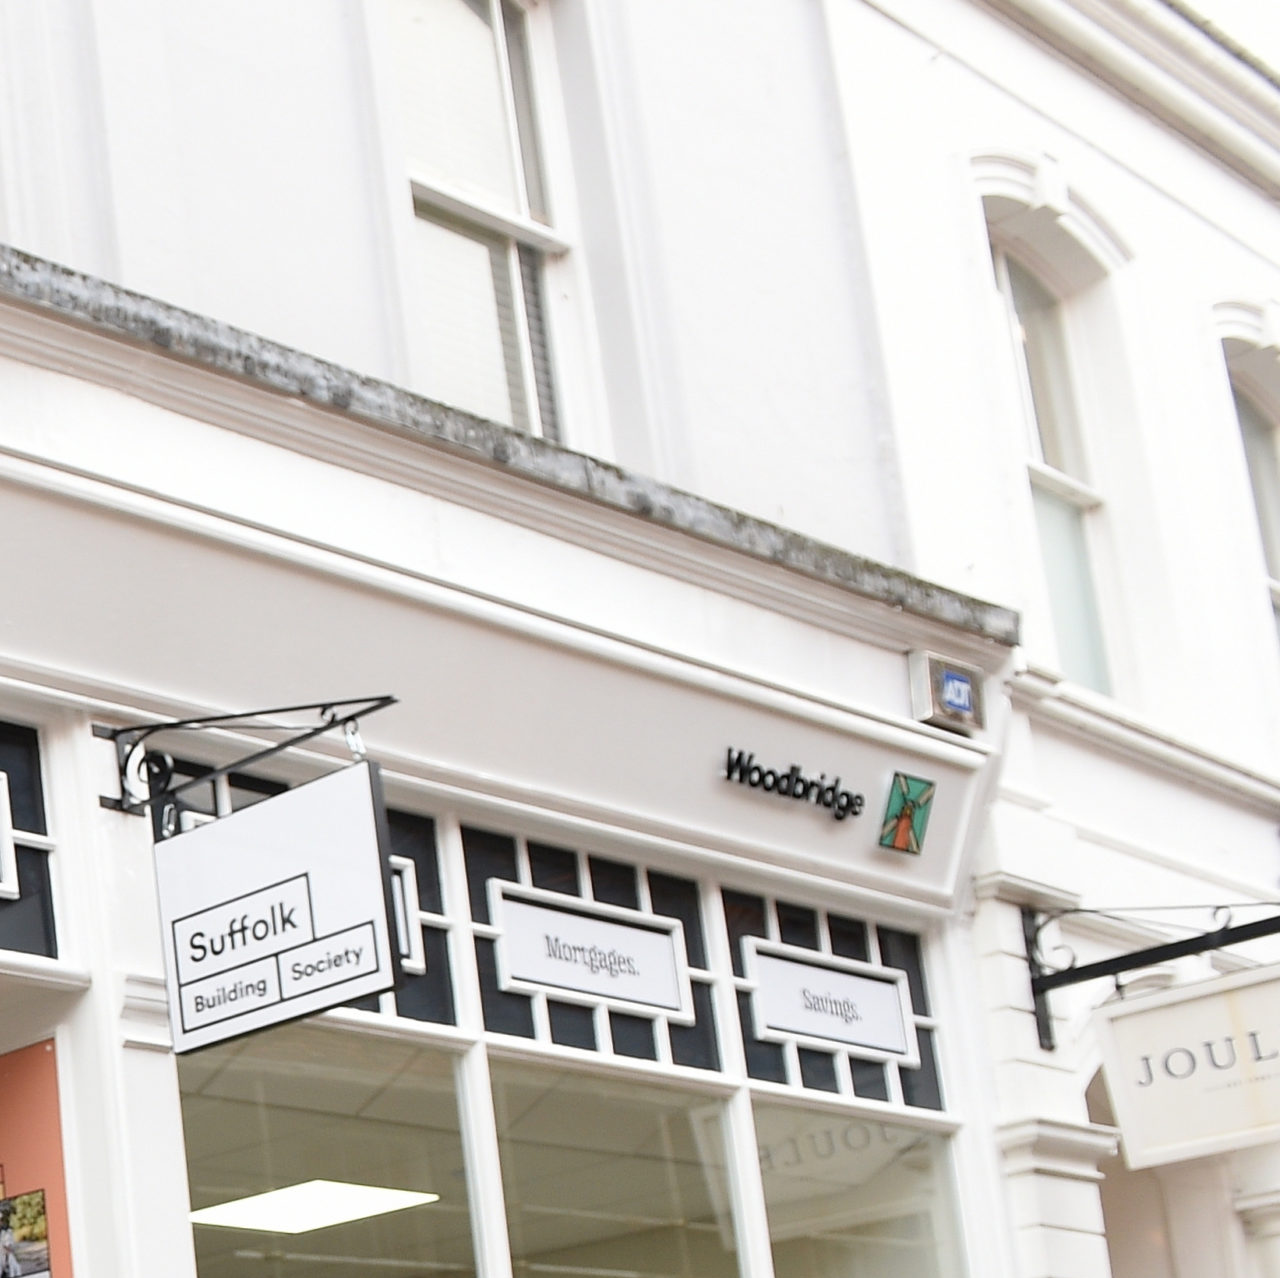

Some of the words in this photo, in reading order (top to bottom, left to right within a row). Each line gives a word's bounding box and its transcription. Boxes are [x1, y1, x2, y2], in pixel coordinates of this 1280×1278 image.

[725, 747, 865, 821] Woodbridge
[190, 902, 298, 963] Suffolk
[544, 933, 641, 978] Mortgages.
[194, 979, 267, 1013] Building
[291, 946, 363, 981] Society
[802, 987, 863, 1023] Savings.
